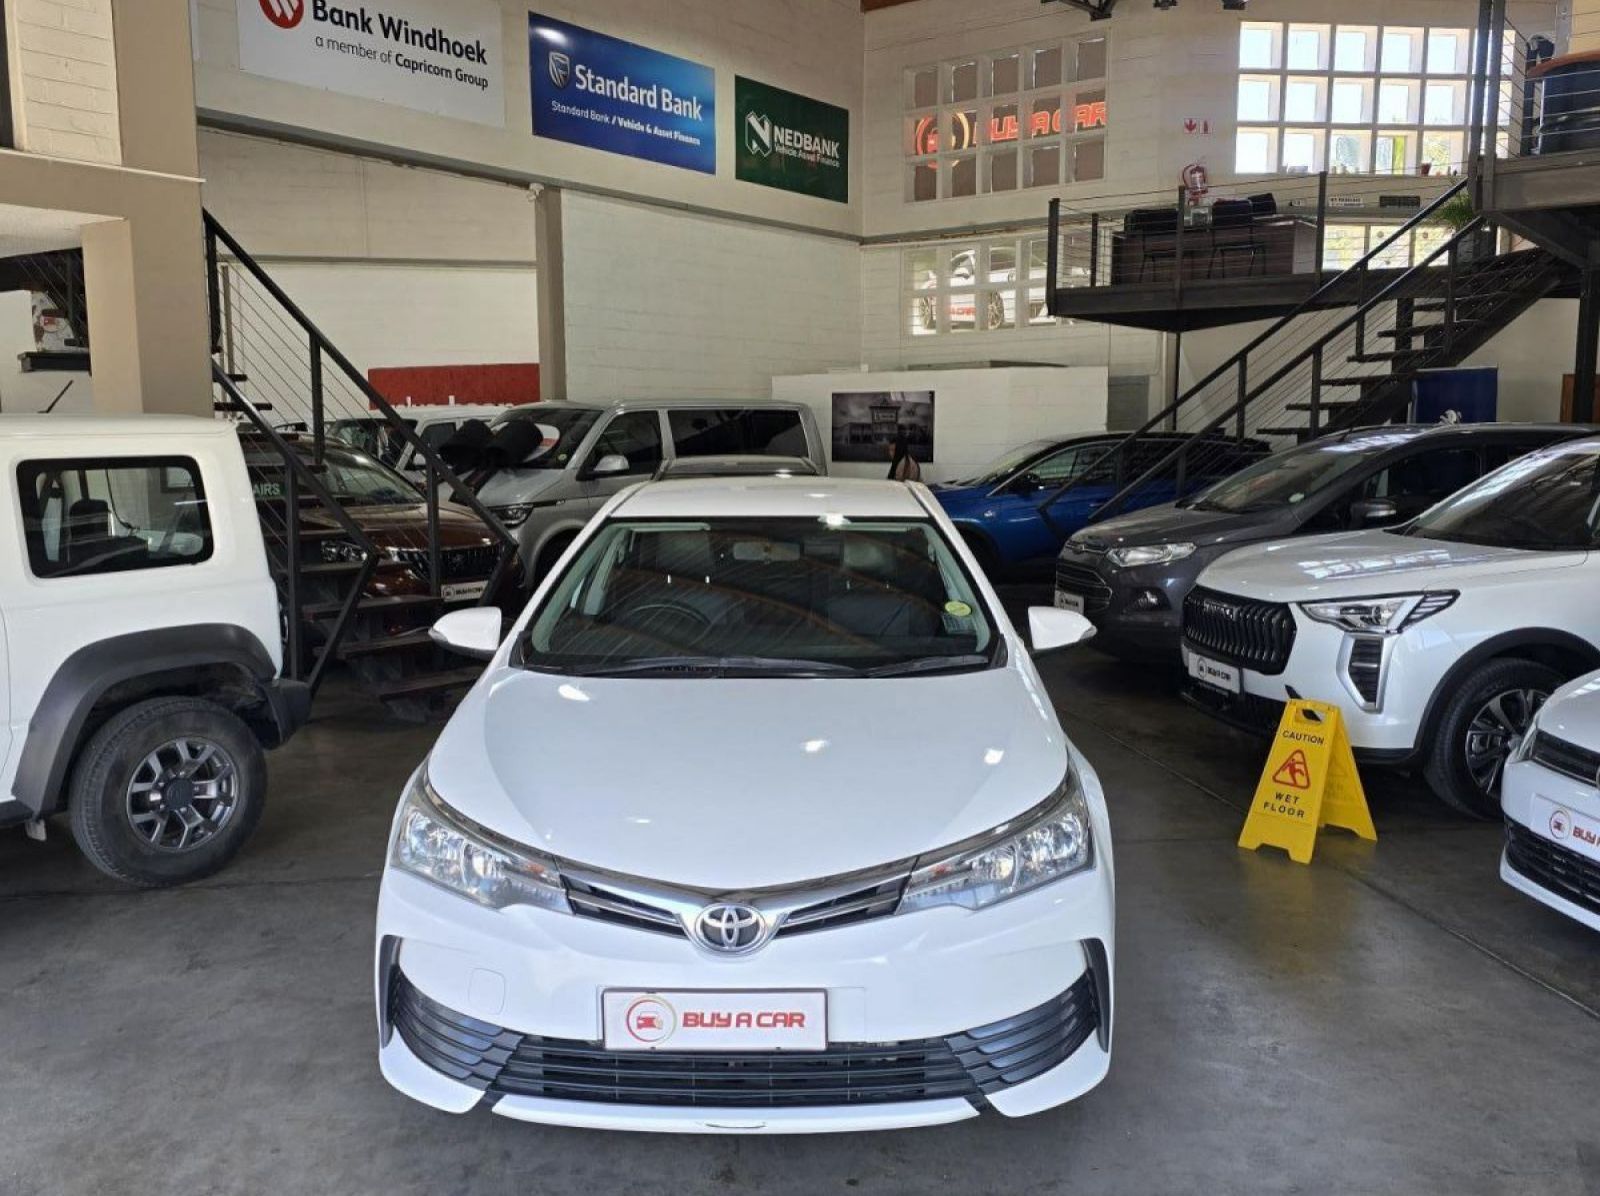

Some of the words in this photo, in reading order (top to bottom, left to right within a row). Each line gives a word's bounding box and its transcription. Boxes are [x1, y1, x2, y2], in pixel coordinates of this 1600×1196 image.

[312, 0, 373, 35] Bank
[378, 13, 488, 66] Windhoek
[315, 36, 324, 48] a
[327, 38, 377, 61] member
[380, 50, 393, 65] of
[395, 53, 453, 79] Capricorn
[455, 68, 489, 92] Group
[575, 64, 657, 110] Standard
[661, 88, 703, 121] Bank
[551, 100, 589, 120] Standard
[590, 108, 610, 124] Bank
[774, 125, 840, 159] NEDBANK
[1282, 729, 1325, 746] CAUTION
[1263, 801, 1306, 818] FLOOR
[1274, 791, 1300, 804] WET
[682, 1012, 732, 1028] BUY
[735, 1012, 752, 1028] A
[755, 1012, 806, 1028] CAR
